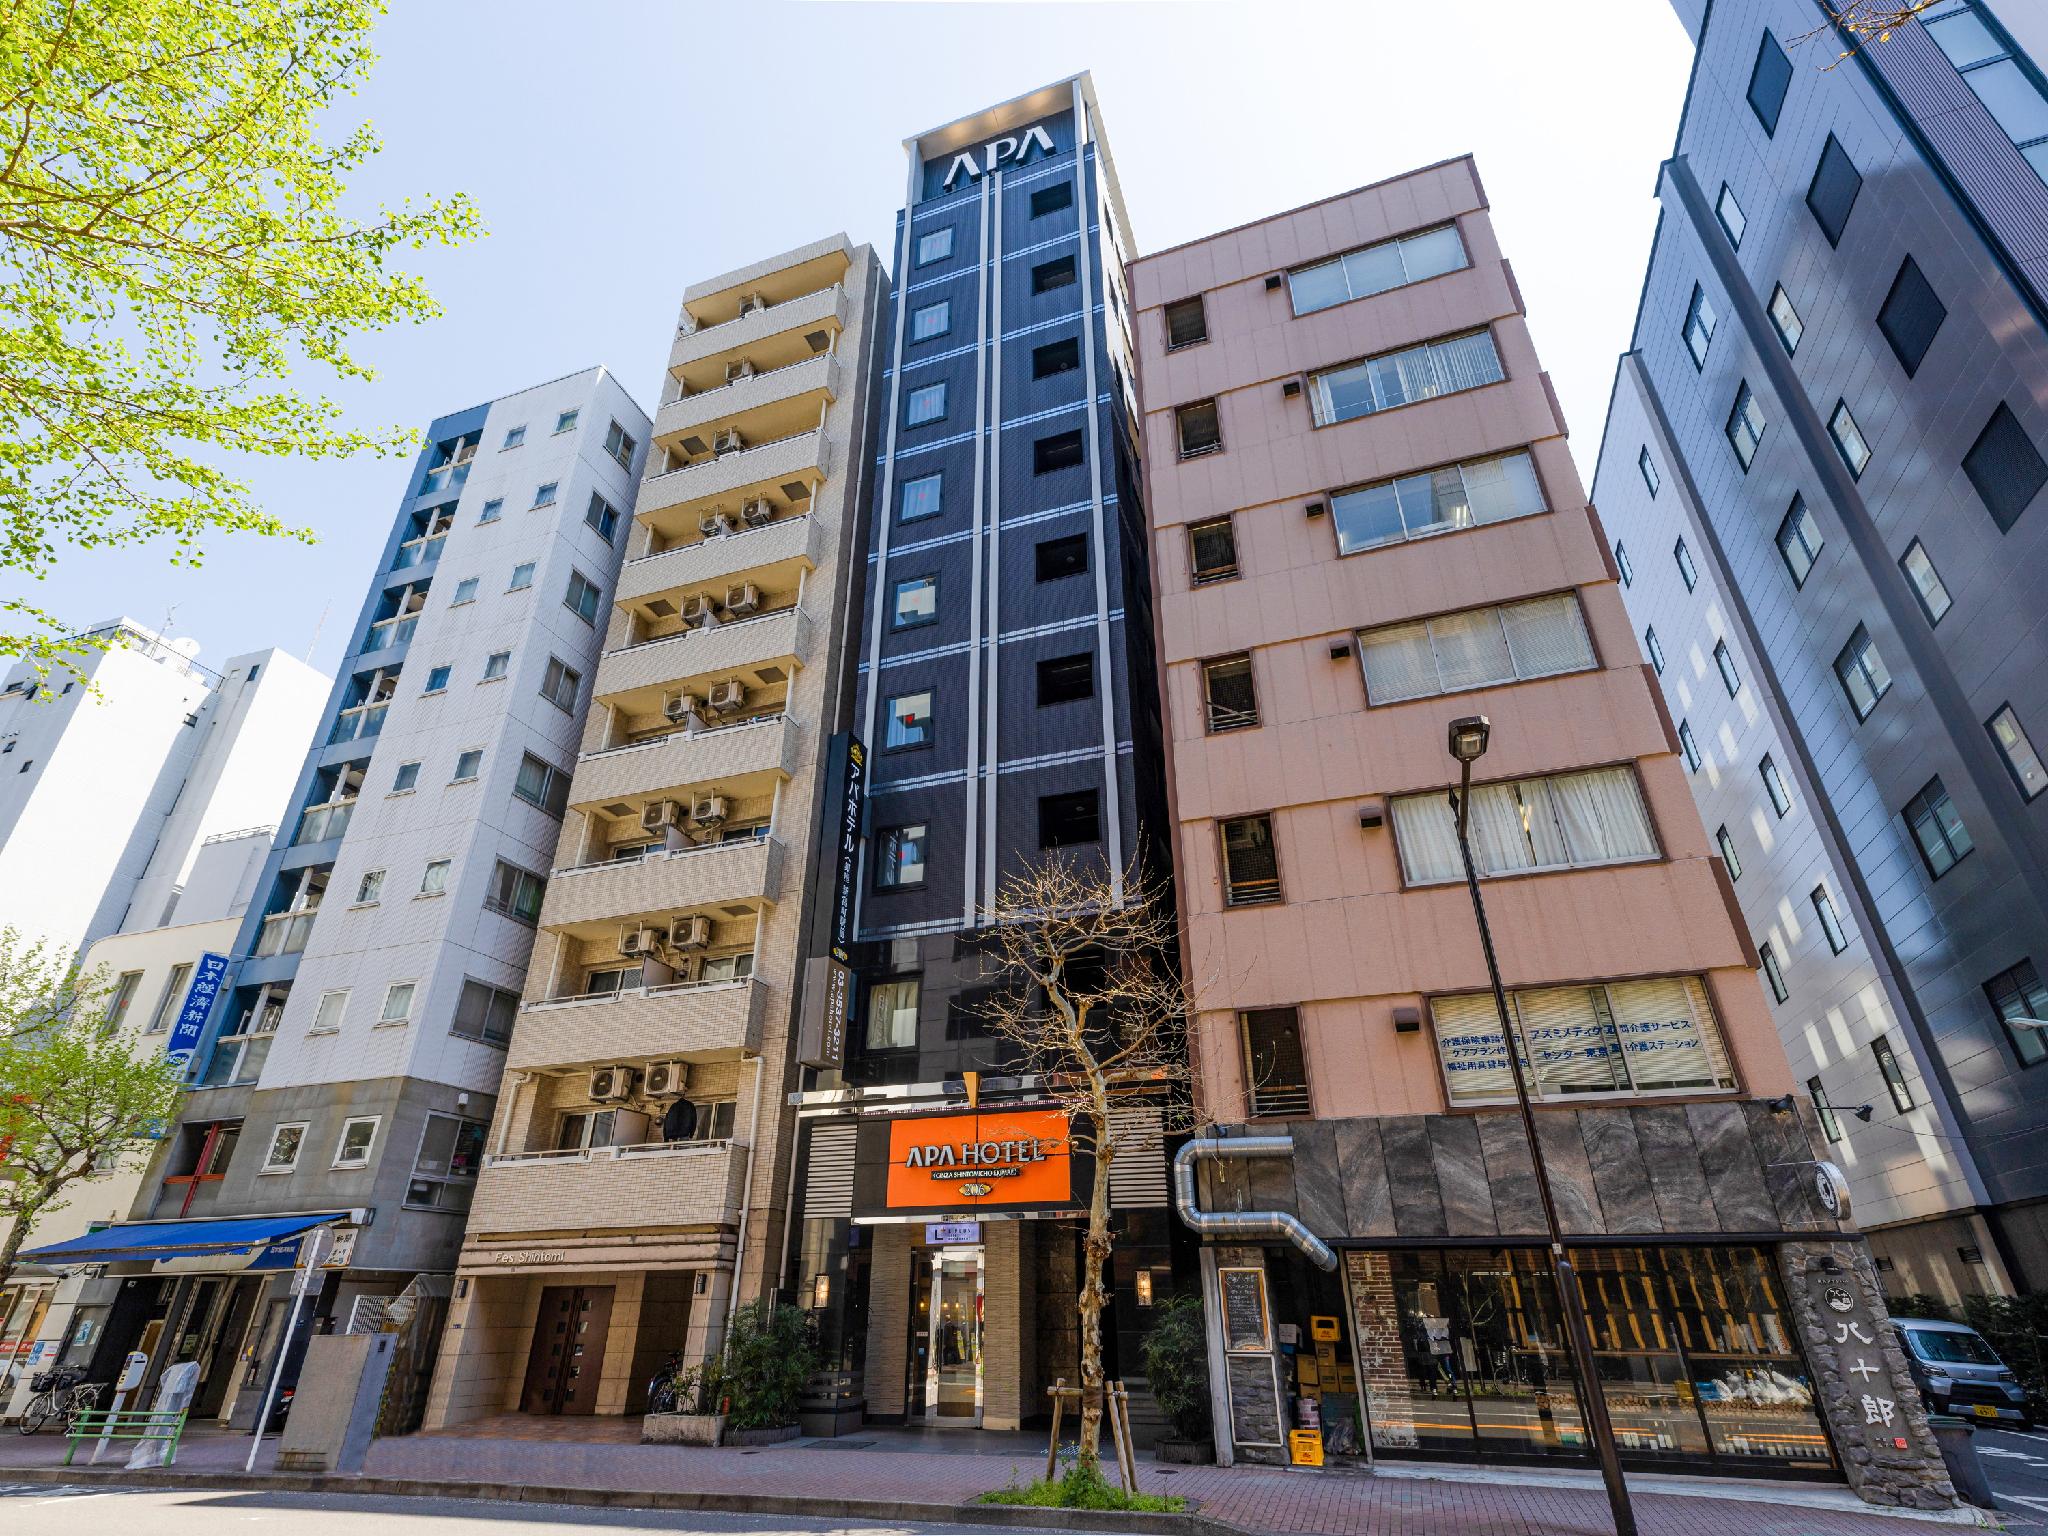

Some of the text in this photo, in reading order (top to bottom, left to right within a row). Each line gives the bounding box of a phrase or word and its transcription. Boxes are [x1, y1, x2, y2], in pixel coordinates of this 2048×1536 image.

[943, 125, 1057, 191] APA
[843, 762, 860, 853] アパホテル
[905, 1139, 1047, 1168] APA HOTEL
[495, 1250, 566, 1263] Fes Shintomi
[1833, 1321, 1895, 1428] 八十郎
